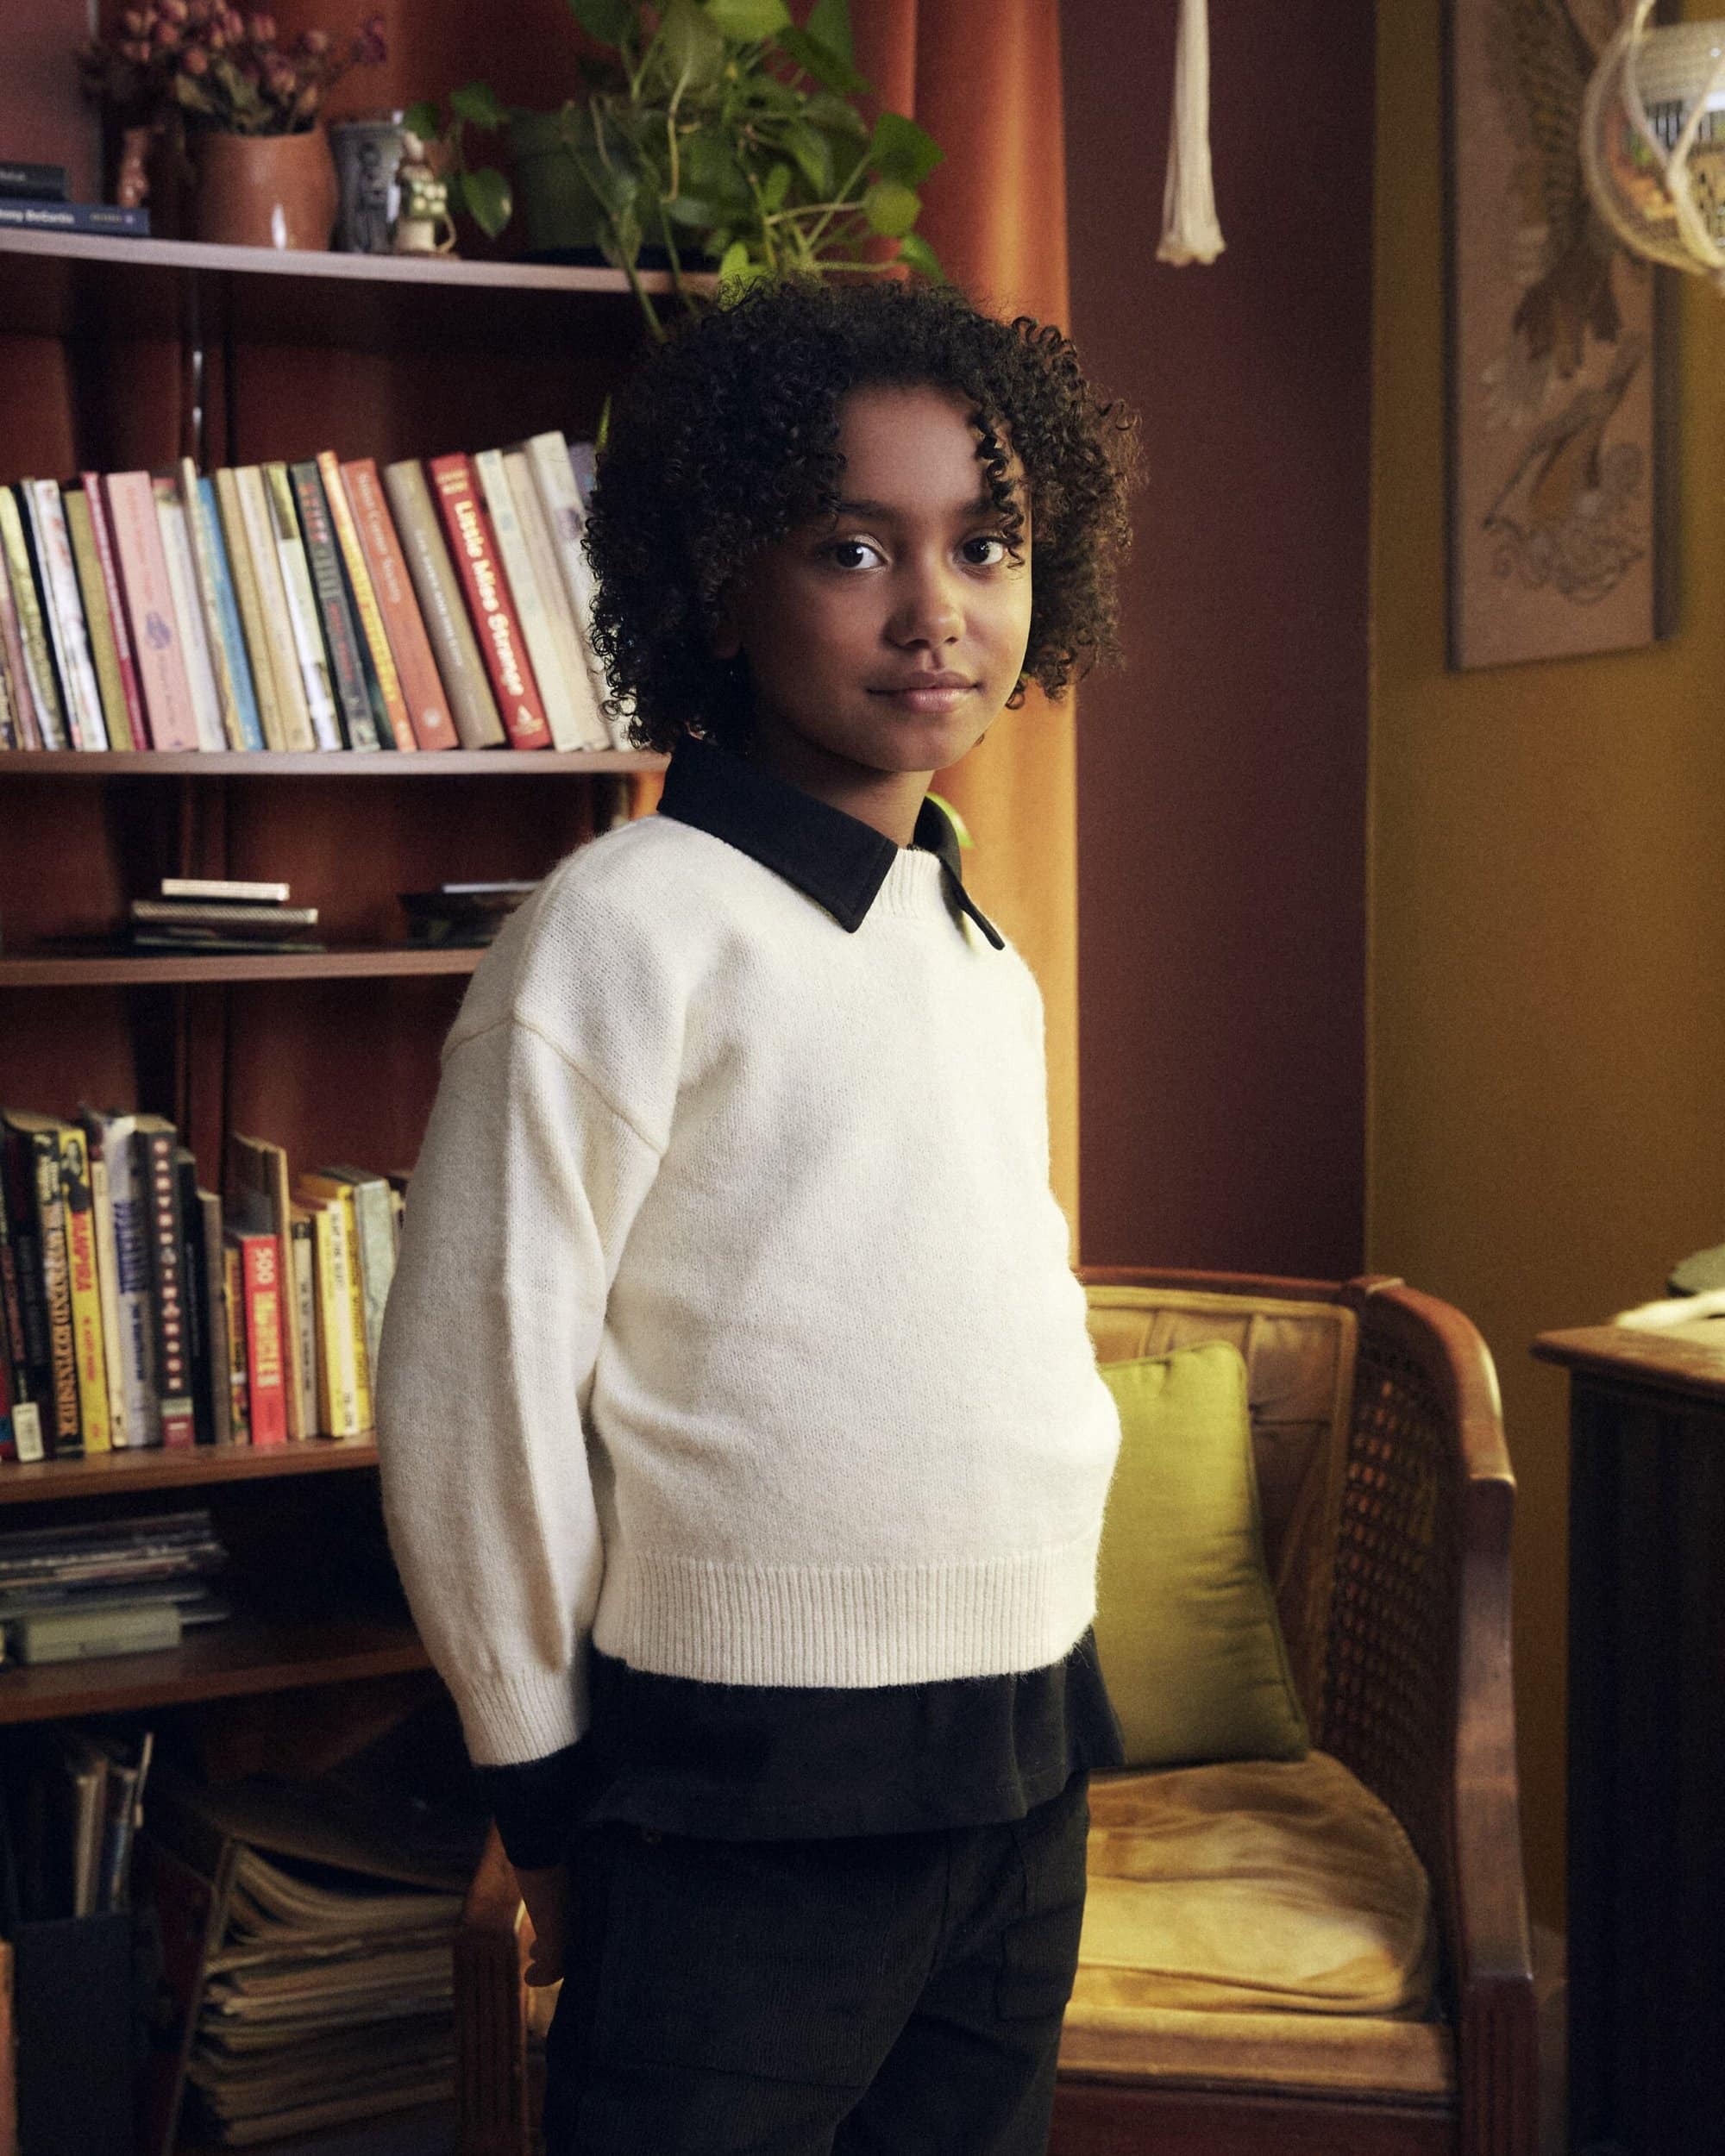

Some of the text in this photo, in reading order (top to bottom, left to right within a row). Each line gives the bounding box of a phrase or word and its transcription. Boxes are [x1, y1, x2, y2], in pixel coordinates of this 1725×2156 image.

[455, 500, 524, 696] Little Miss Strange
[254, 1247, 275, 1284] 500
